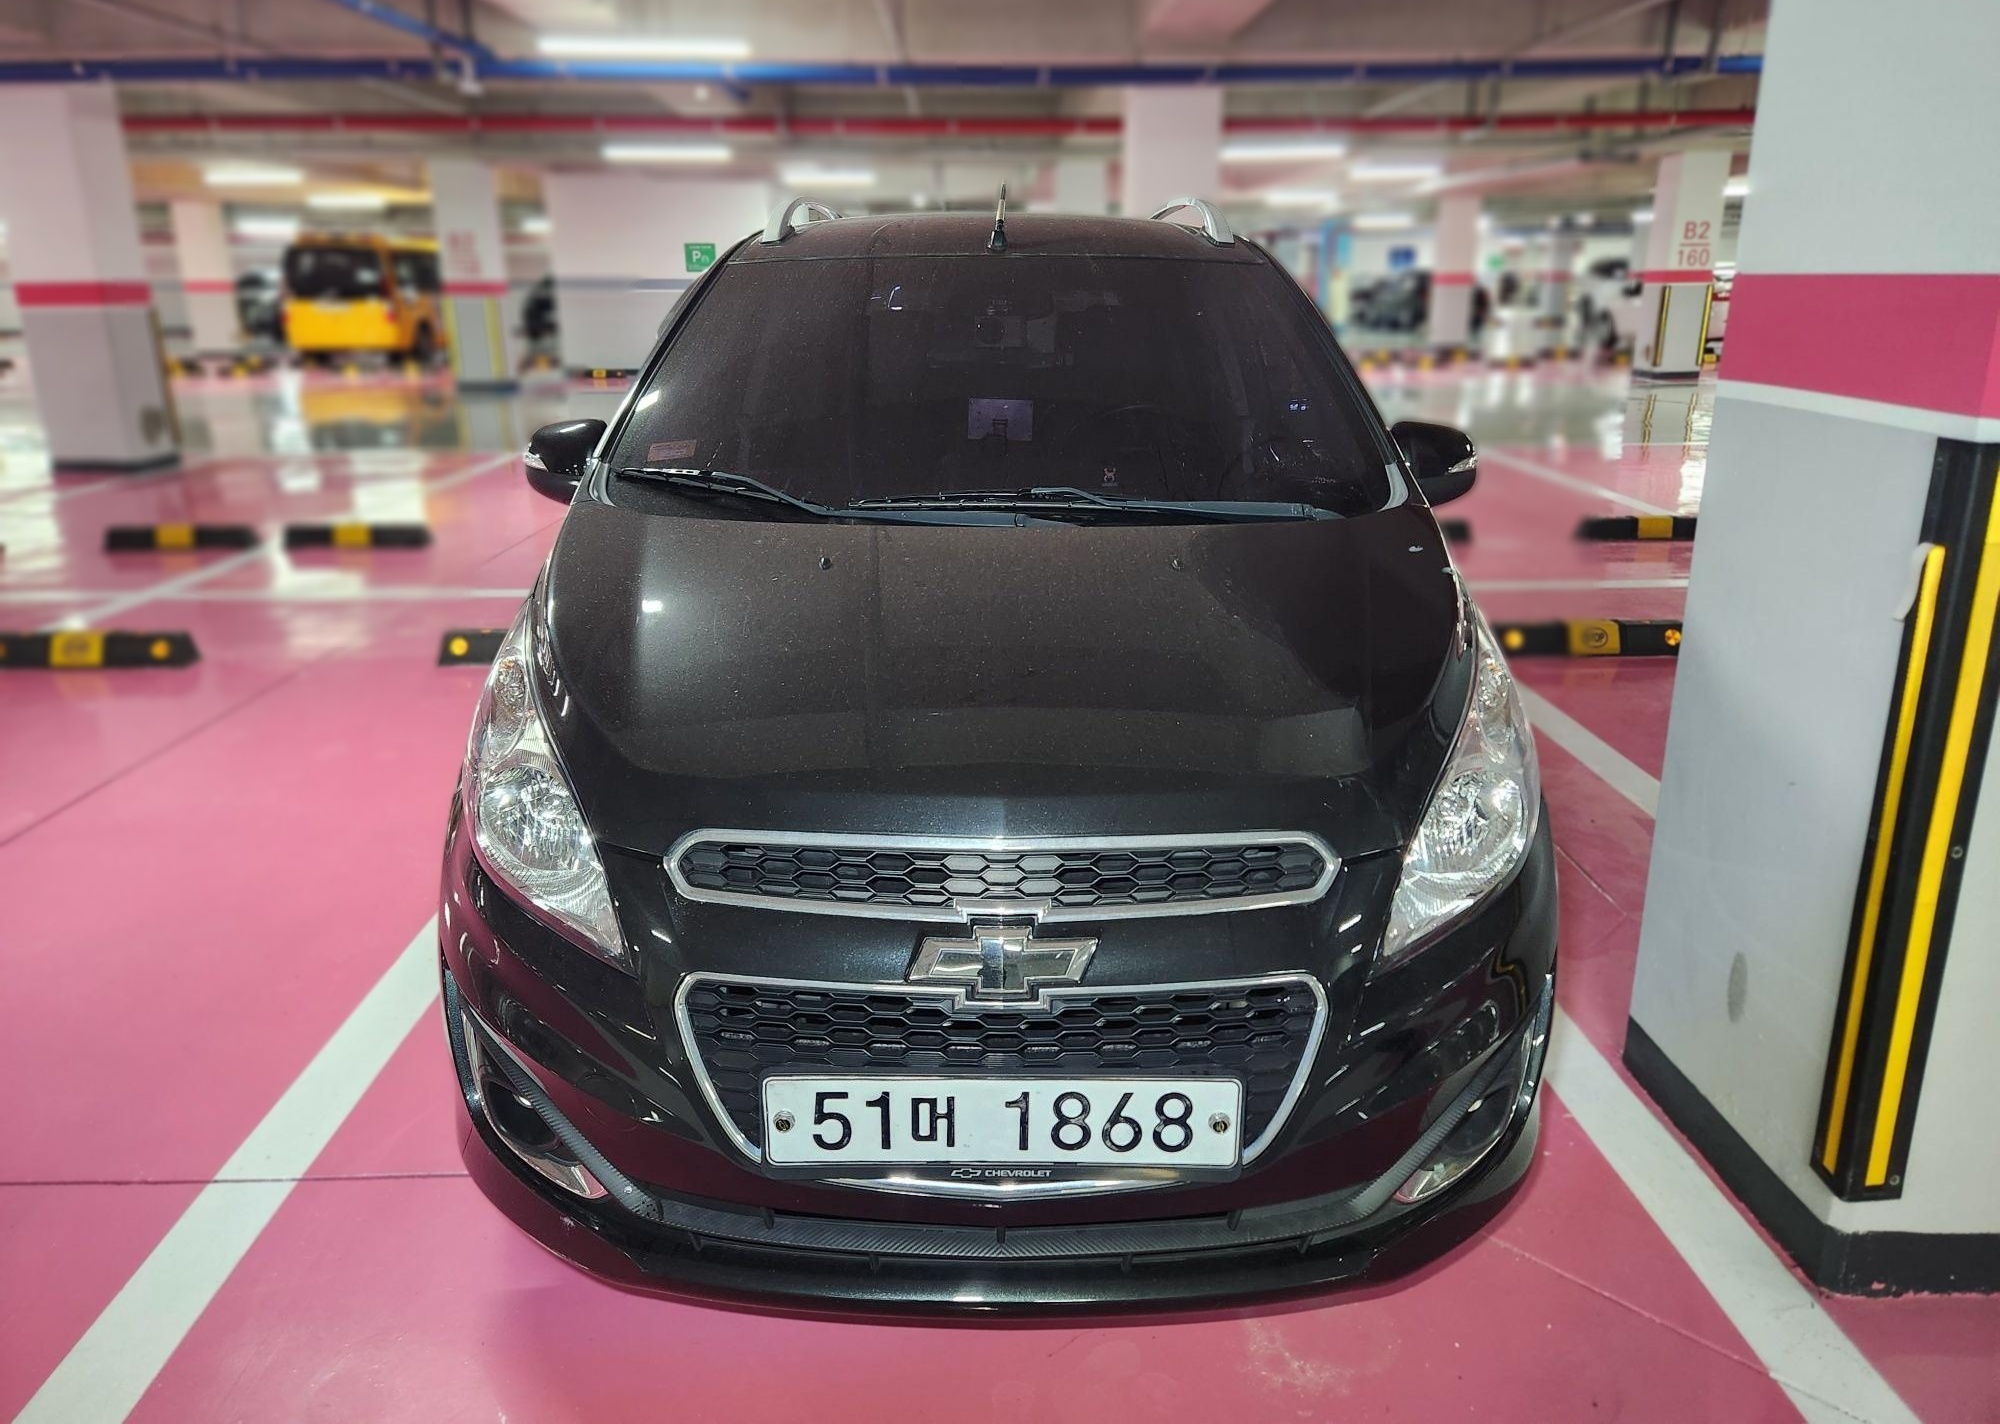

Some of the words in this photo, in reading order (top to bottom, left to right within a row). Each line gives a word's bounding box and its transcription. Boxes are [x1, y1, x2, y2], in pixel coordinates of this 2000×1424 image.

[1684, 220, 1710, 240] B2
[1678, 248, 1710, 267] 160
[812, 1091, 955, 1150] 51머
[1005, 1091, 1193, 1152] 1868
[985, 1169, 1052, 1177] CHEVROLET
